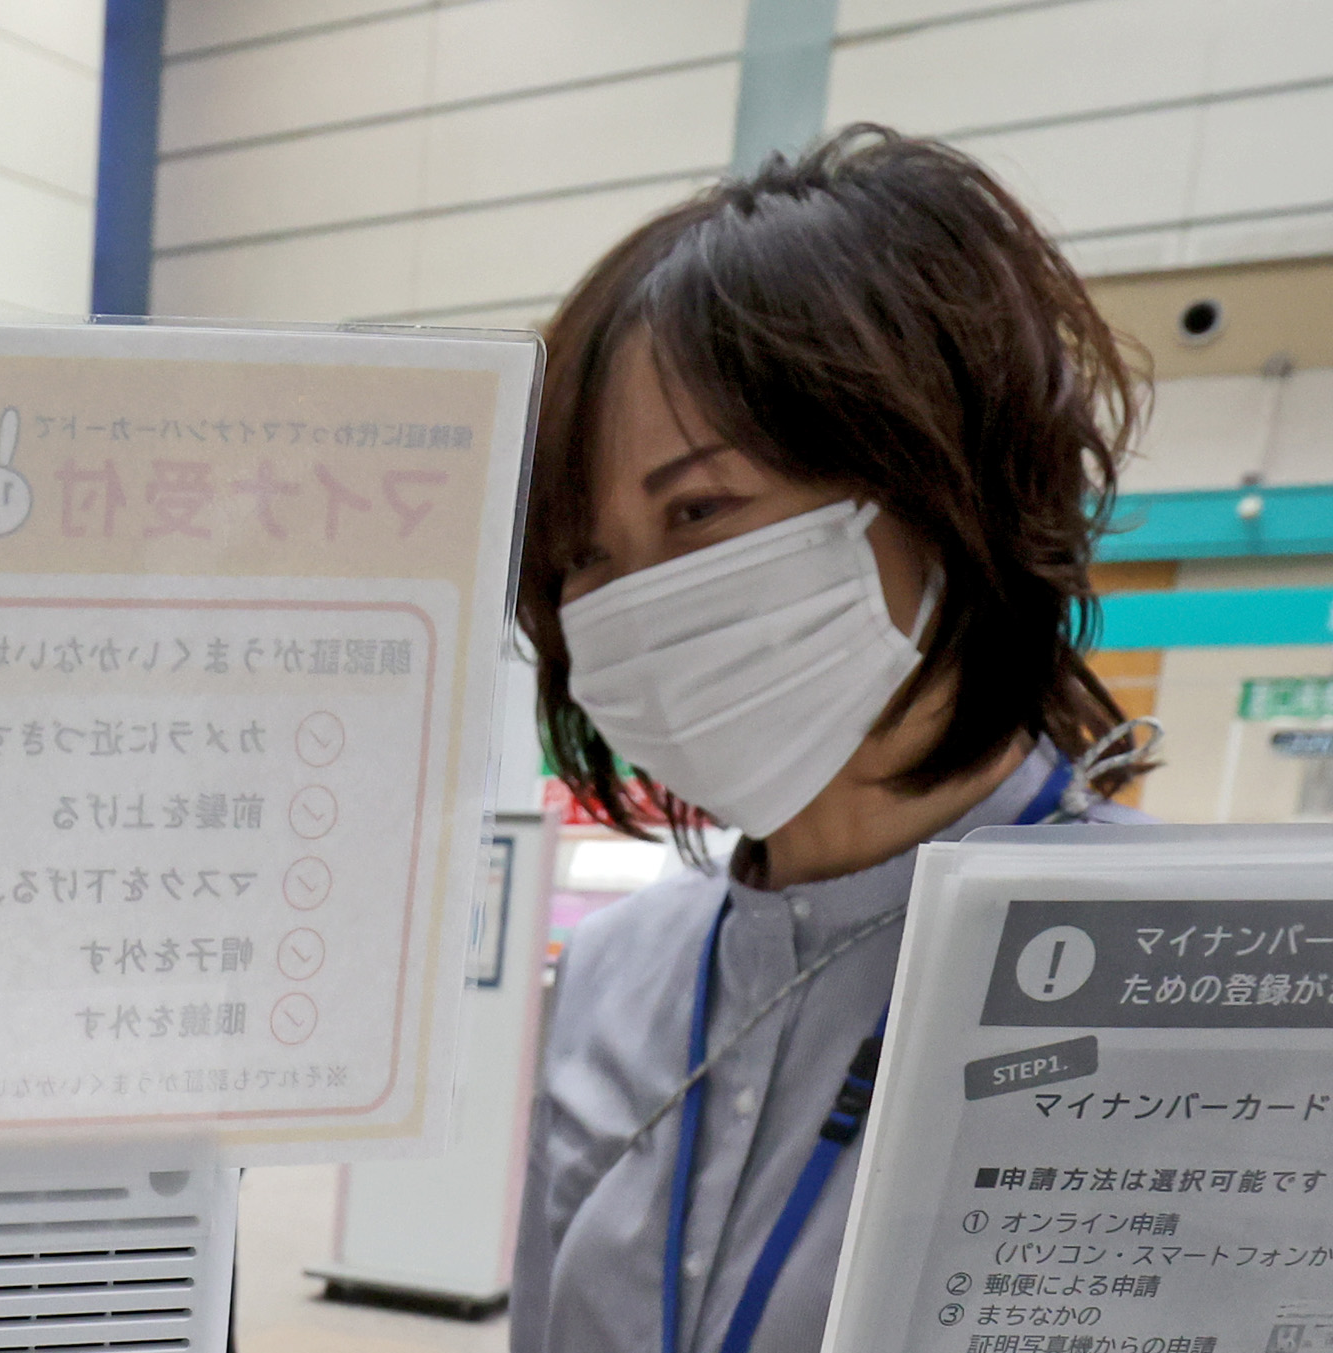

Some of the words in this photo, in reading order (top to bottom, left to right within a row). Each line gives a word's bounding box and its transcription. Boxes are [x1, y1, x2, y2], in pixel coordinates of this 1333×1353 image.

[1120, 974, 1333, 1006] ための登録が
[993, 1055, 1069, 1086] STEP1.
[1035, 1092, 1329, 1121] マイナンバーカード
[1001, 1212, 1180, 1236] オンライン申請
[984, 1274, 1160, 1299] 郵便による申請
[977, 1306, 1101, 1327] まちなかの
